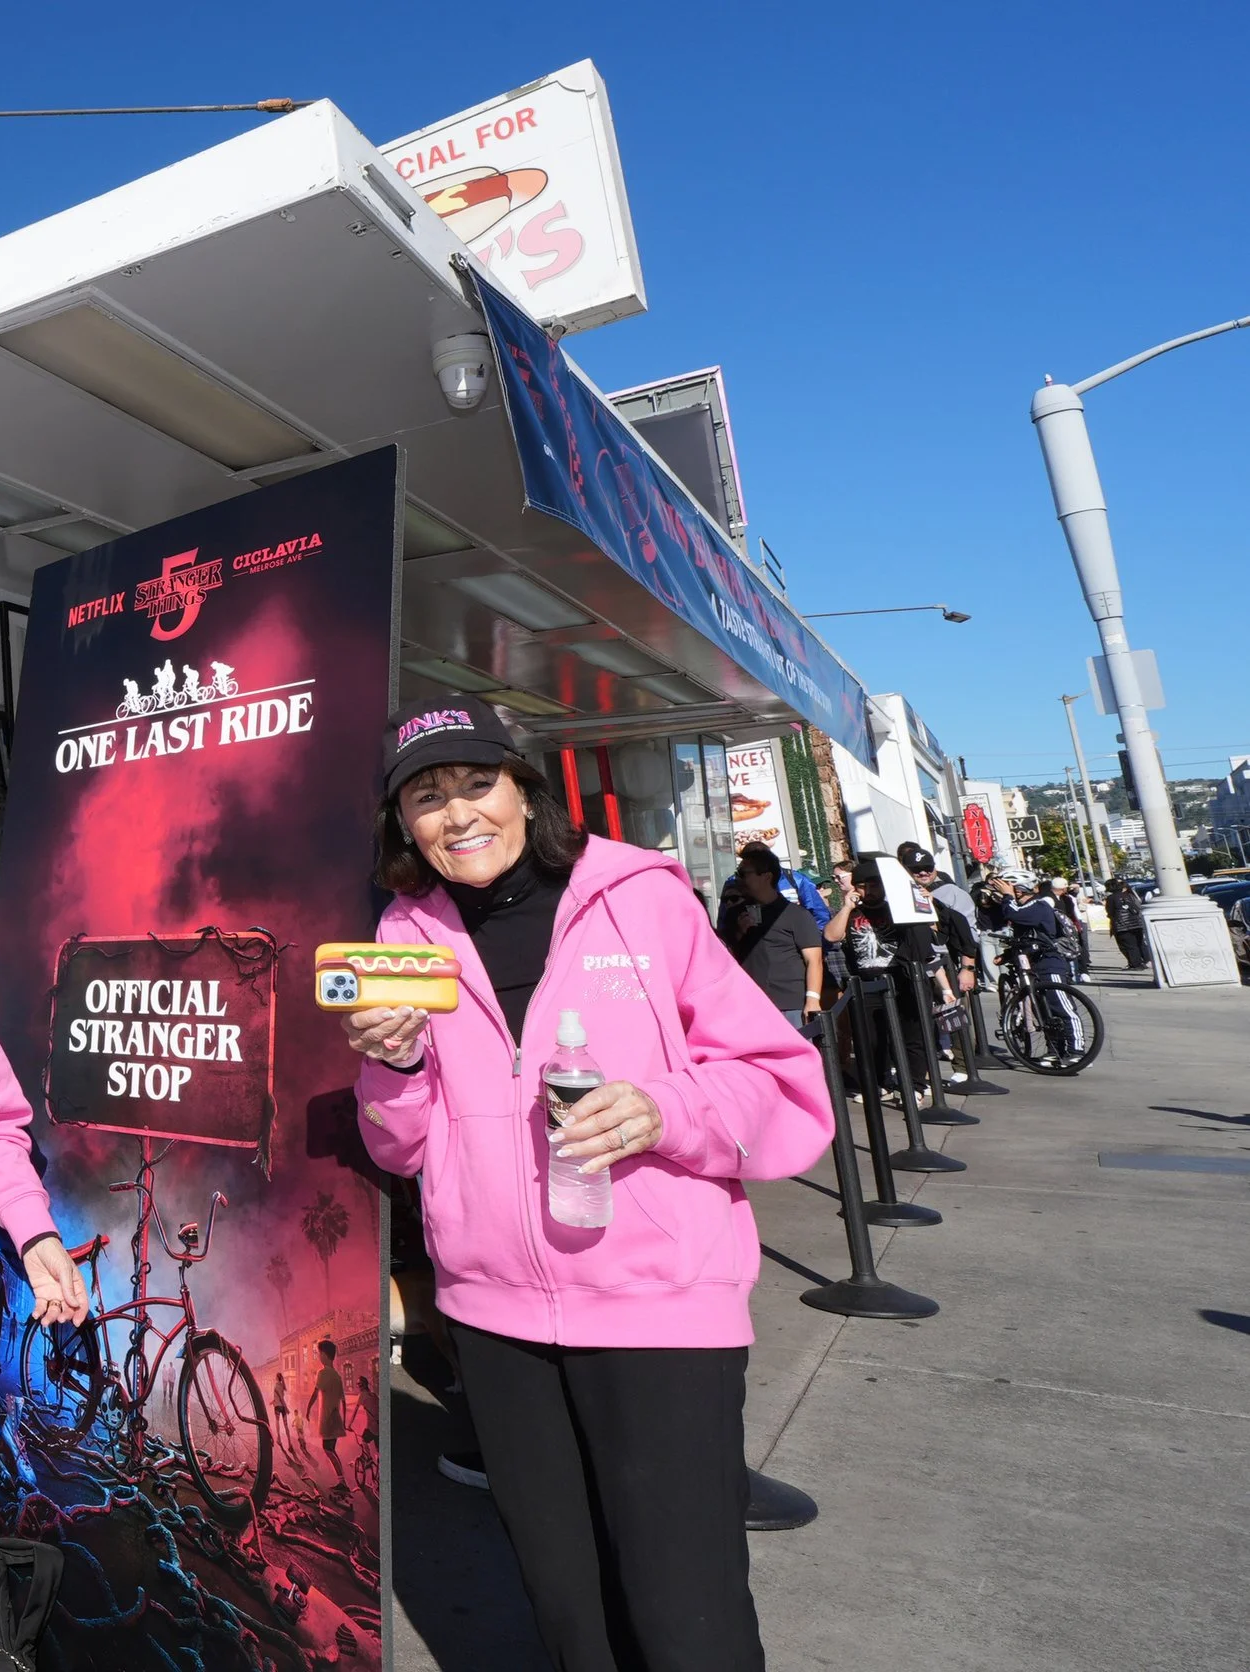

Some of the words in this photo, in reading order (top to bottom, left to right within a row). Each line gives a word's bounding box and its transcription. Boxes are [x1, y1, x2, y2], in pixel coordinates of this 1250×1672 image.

[475, 106, 538, 150] FOR
[233, 532, 323, 571] CICLAVIA
[249, 558, 285, 575] MELROSE
[286, 552, 303, 565] AVE
[134, 562, 223, 607] STRANGER
[147, 587, 207, 618] THINGS
[67, 591, 126, 629] NETFLIX
[55, 730, 118, 774] ONE
[123, 710, 211, 763] LAST
[218, 691, 315, 747] RIDE
[398, 709, 472, 747] PINK'S
[728, 750, 767, 769] NCES
[969, 809, 987, 857] NAILS
[582, 954, 651, 972] PINK'S
[84, 979, 228, 1017] OFFICIAL
[68, 1018, 243, 1063] STRANGER
[106, 1061, 192, 1102] STOP
